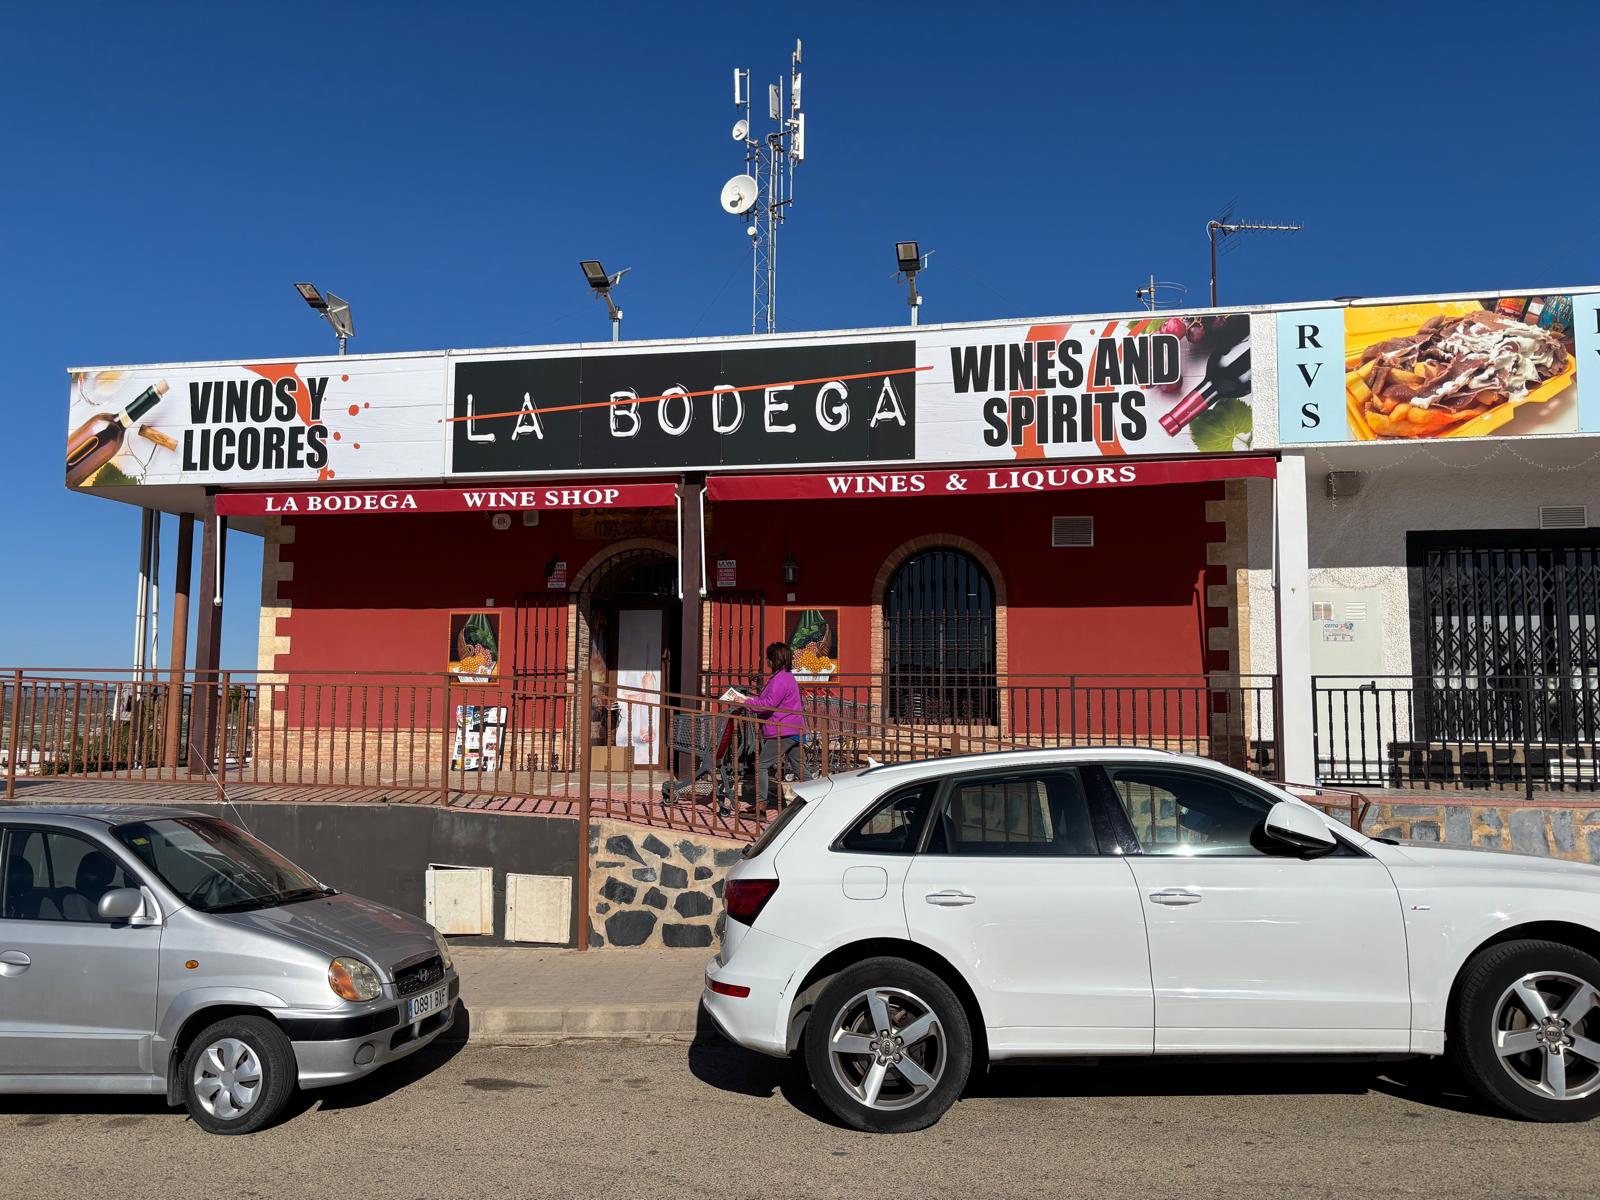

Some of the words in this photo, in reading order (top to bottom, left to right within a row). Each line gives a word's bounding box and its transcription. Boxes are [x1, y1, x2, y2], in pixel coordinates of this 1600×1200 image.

[950, 340, 1084, 394] WINES
[1094, 335, 1181, 387] AND
[189, 378, 298, 424] VINOS
[308, 377, 329, 421] Y
[466, 391, 544, 443] LA
[609, 376, 907, 438] BODEGA
[983, 391, 1147, 447] SPIRITS
[182, 424, 329, 472] LICORES
[265, 496, 299, 512] LA
[306, 493, 418, 511] BODEGA
[462, 490, 537, 508] WINE
[544, 488, 620, 506] SHOP
[826, 474, 926, 494] WINES
[945, 473, 968, 491] &
[987, 465, 1137, 490] LIQUORS
[413, 994, 433, 1015] 0891
